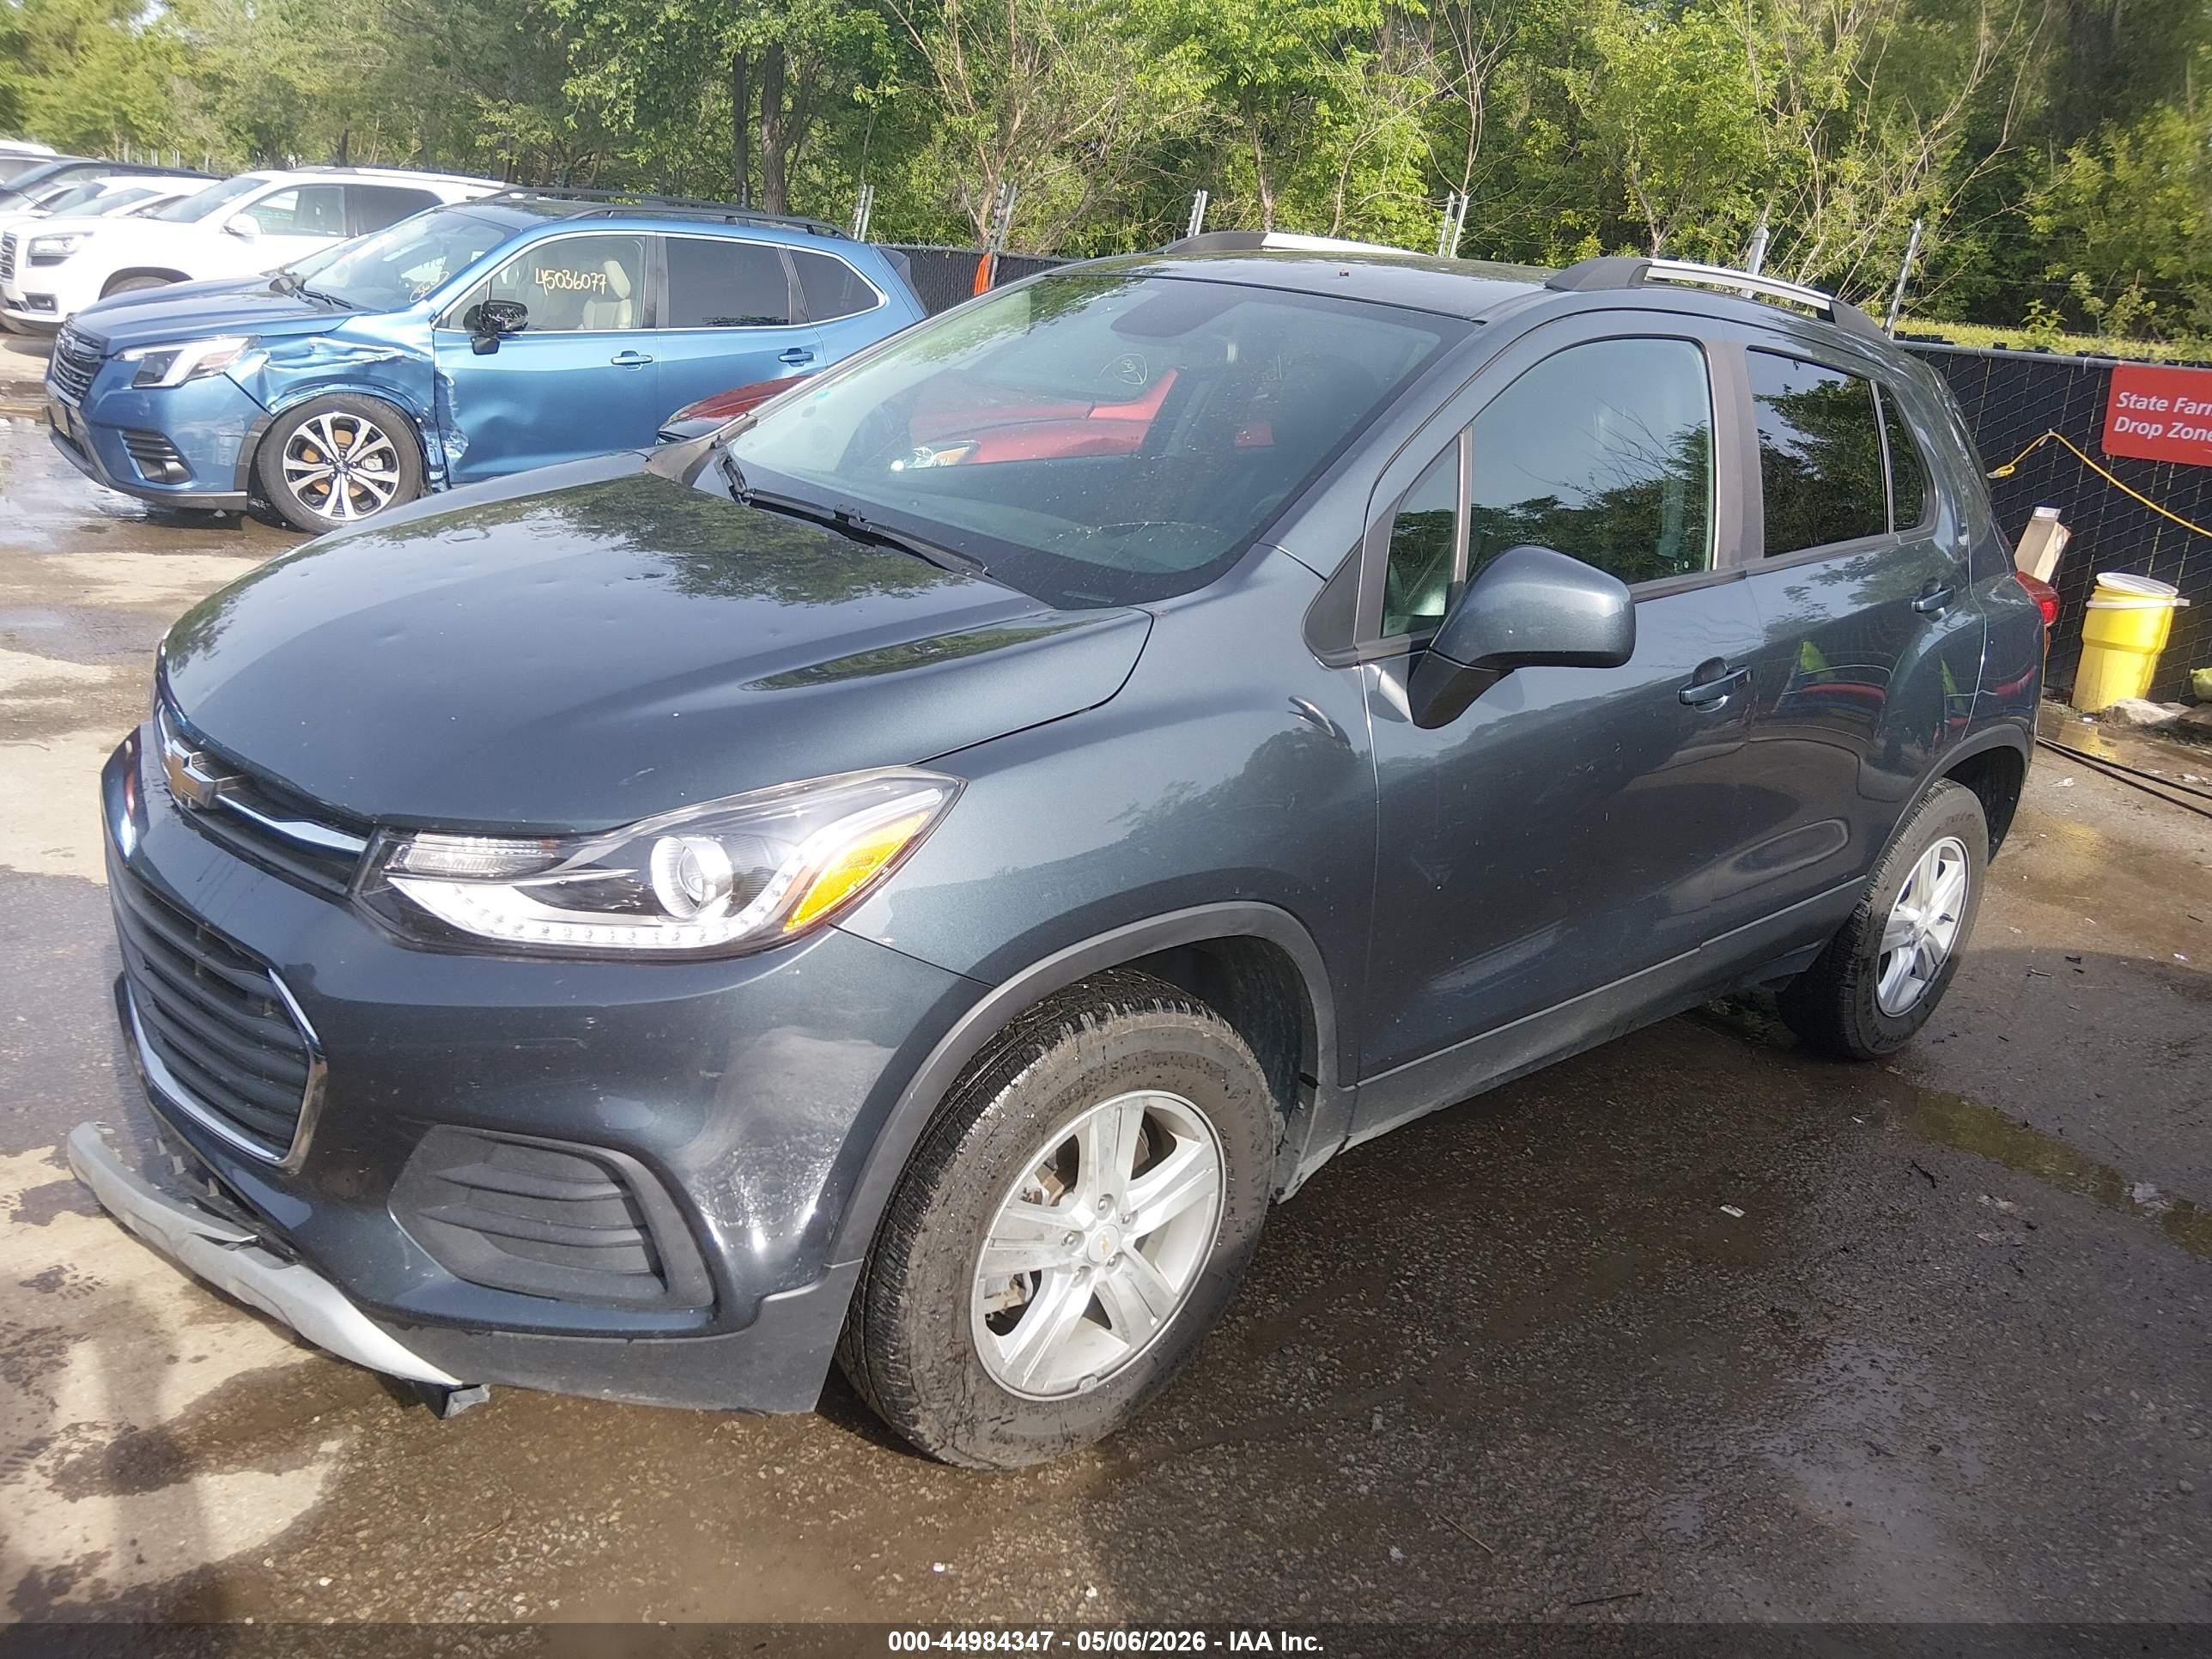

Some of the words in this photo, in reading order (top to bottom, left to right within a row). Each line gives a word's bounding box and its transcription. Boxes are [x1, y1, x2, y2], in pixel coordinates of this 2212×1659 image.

[535, 268, 607, 295] 45036077
[2116, 392, 2169, 412] State
[2114, 416, 2163, 440] Drop
